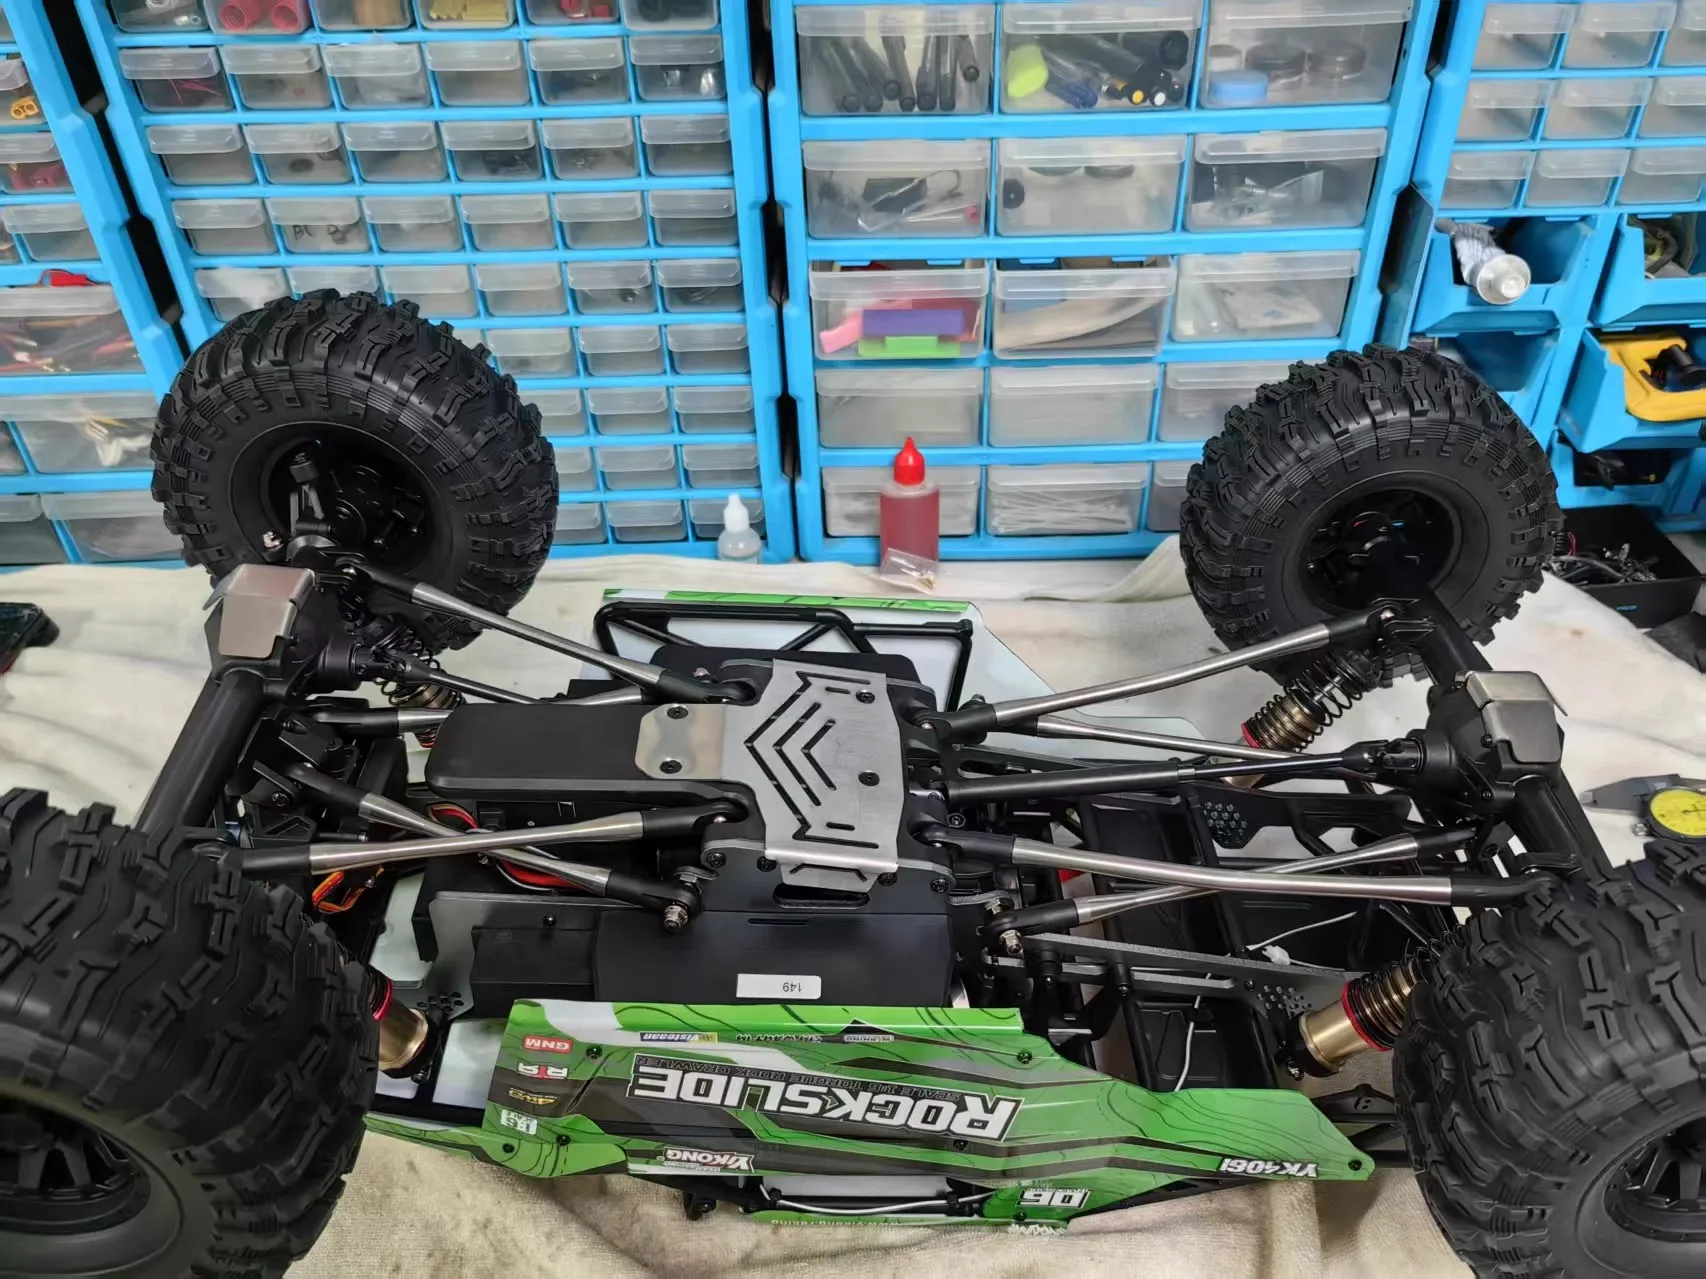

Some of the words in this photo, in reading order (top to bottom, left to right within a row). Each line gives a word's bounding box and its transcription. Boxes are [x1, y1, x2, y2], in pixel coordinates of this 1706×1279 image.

[782, 981, 803, 993] 149
[524, 1038, 570, 1050] GNM
[635, 1056, 731, 1074] CRAWLER
[734, 1066, 787, 1080] ROCK
[634, 1066, 1019, 1140] ROCKSLIDE
